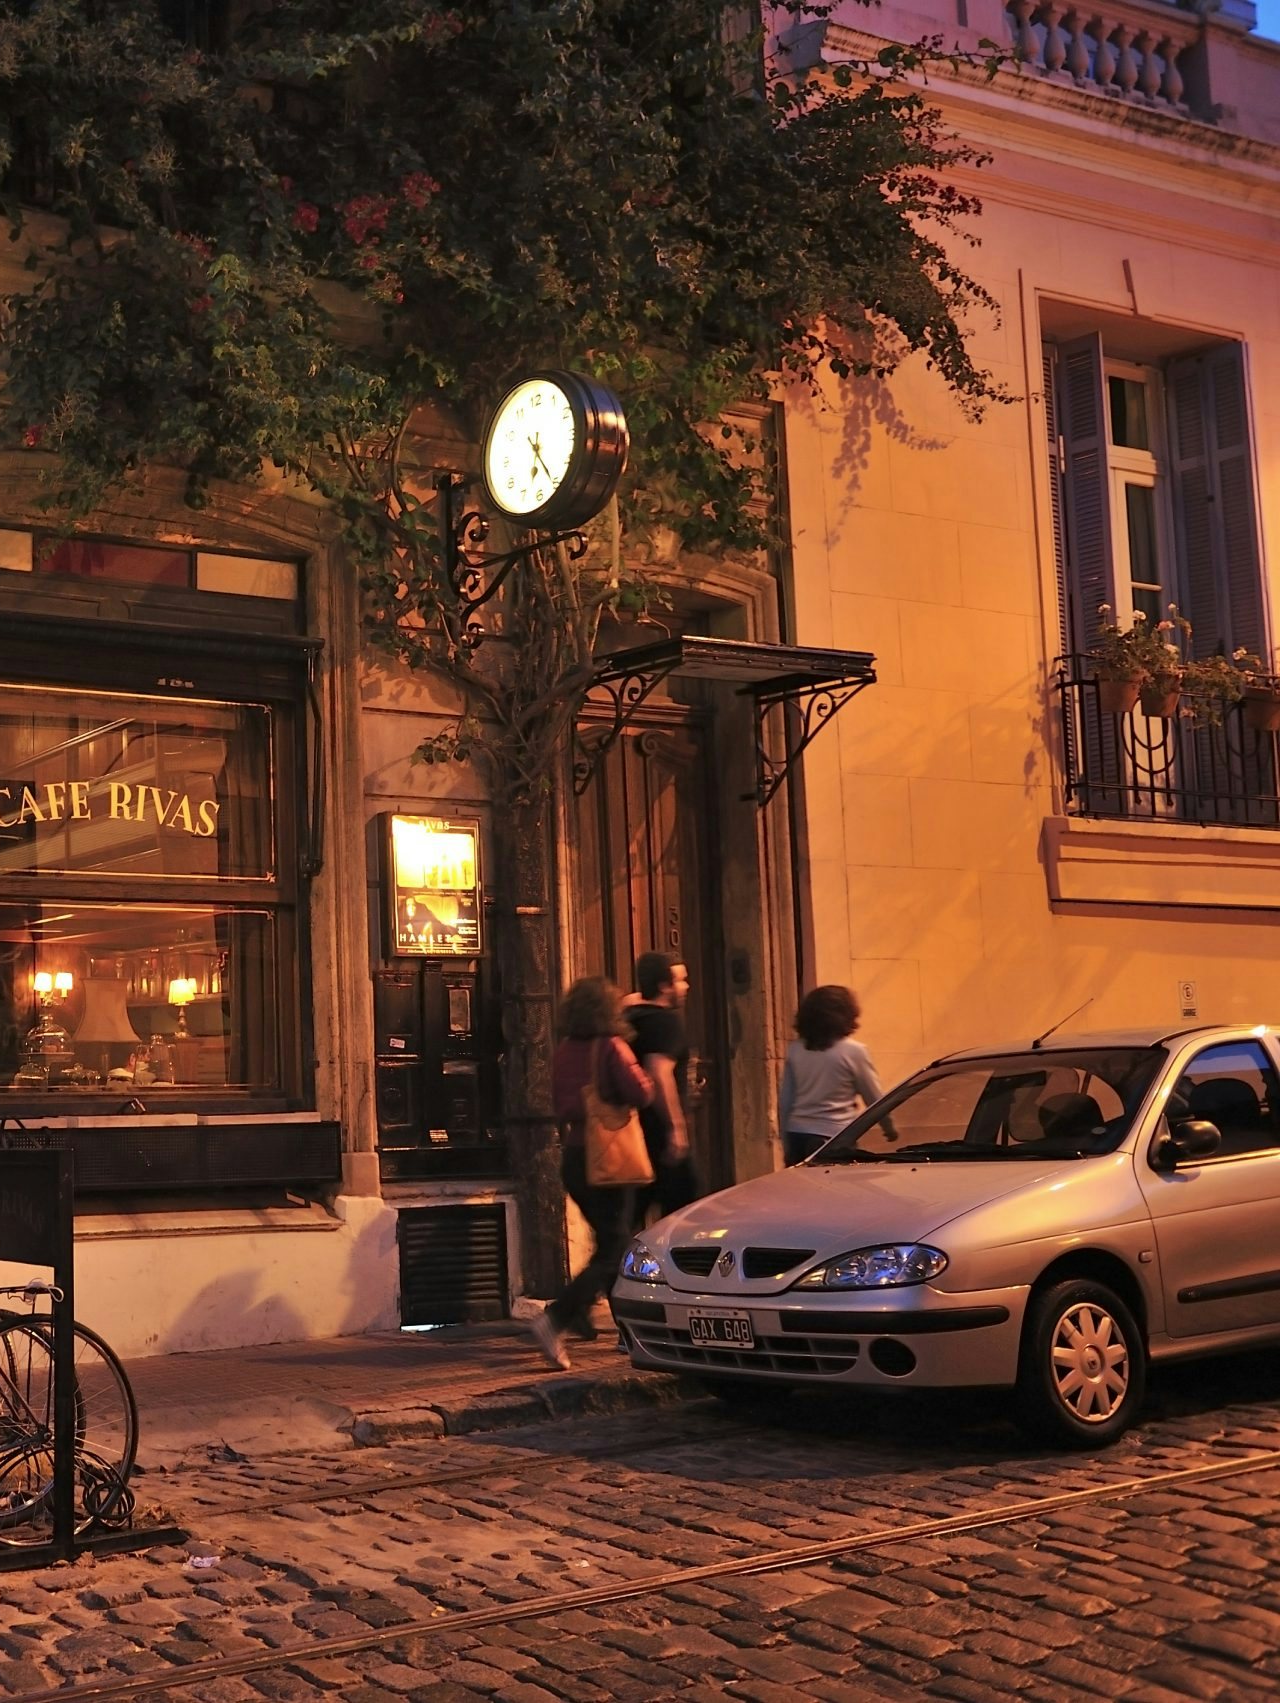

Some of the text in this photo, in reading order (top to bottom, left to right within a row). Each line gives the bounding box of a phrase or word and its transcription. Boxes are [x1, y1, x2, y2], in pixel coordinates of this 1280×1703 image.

[530, 393, 541, 408] 12
[536, 489, 544, 502] 6
[109, 782, 220, 837] RIVAS
[400, 933, 453, 943] HAMLET
[691, 1318, 750, 1341] GAX 648
